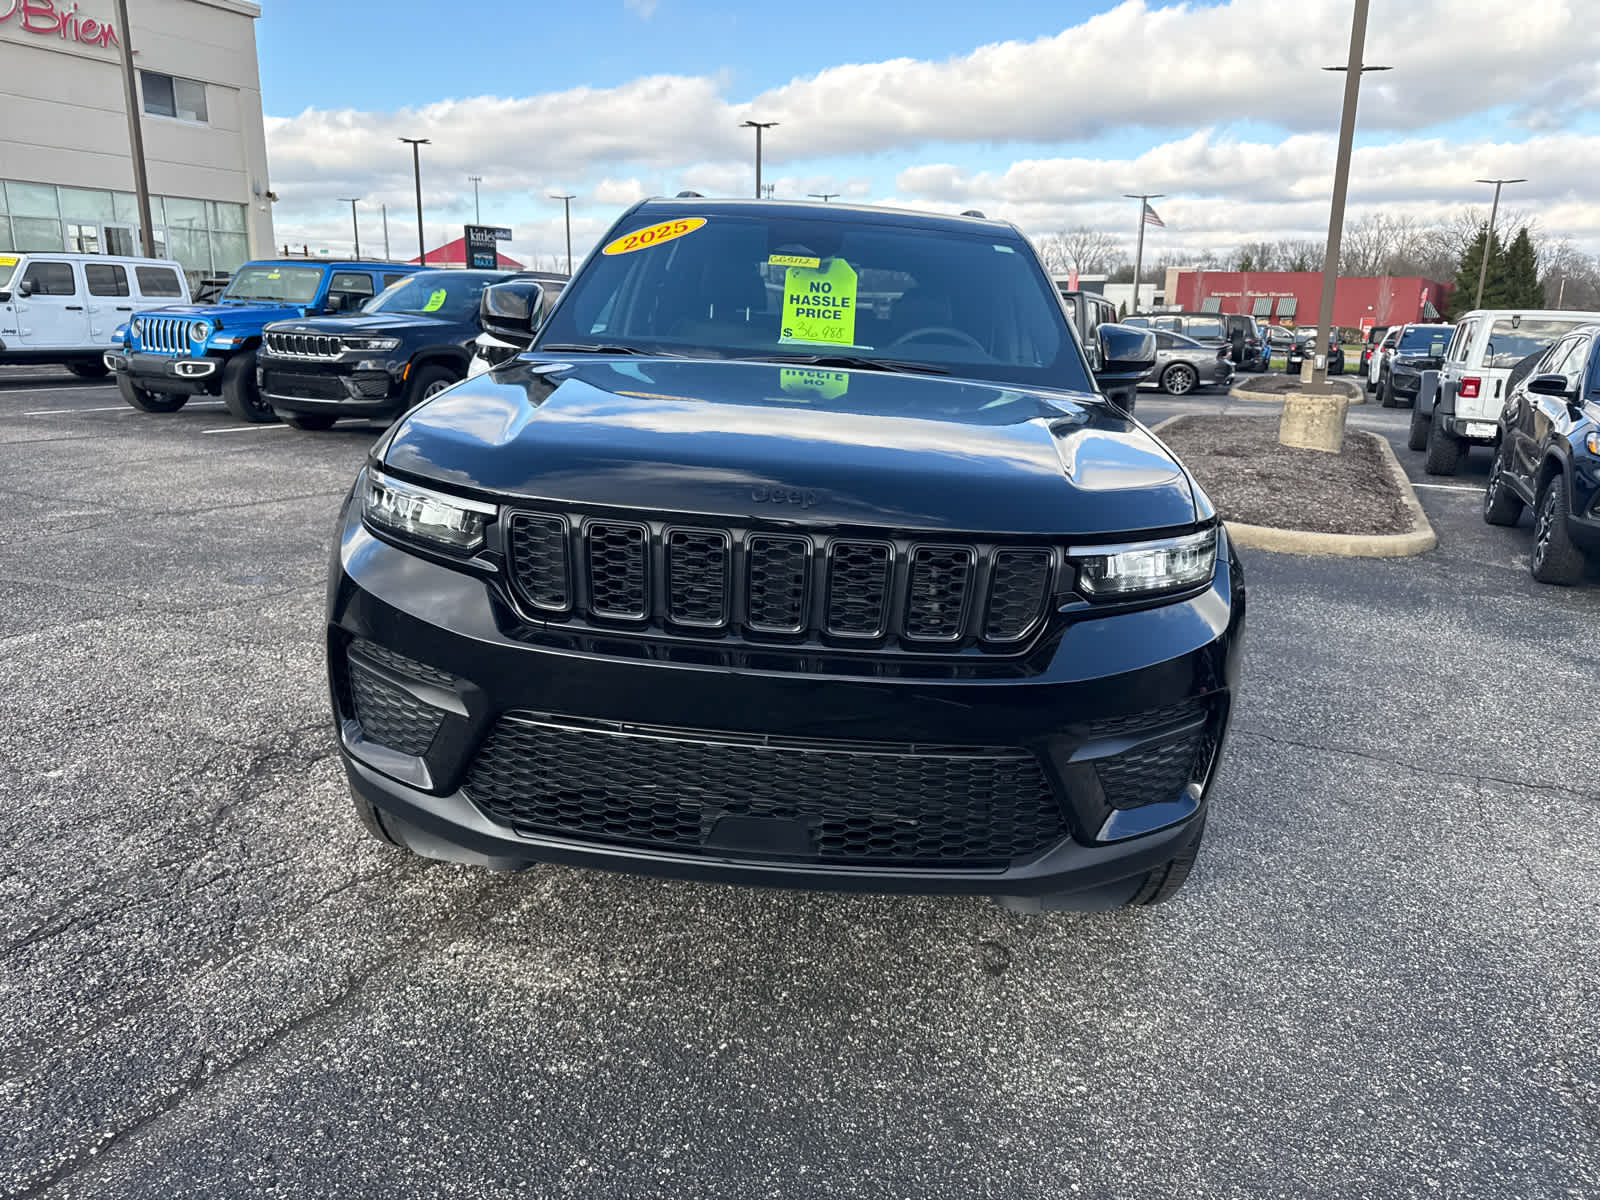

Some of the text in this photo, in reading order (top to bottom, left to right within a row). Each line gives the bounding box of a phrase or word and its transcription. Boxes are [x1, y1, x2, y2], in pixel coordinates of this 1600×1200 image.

[0, 0, 119, 48] Brien
[623, 220, 688, 251] 2025
[809, 281, 832, 293] NO
[789, 294, 850, 308] HASSLE
[795, 307, 842, 320] PRICE
[751, 485, 817, 510] Jeep
